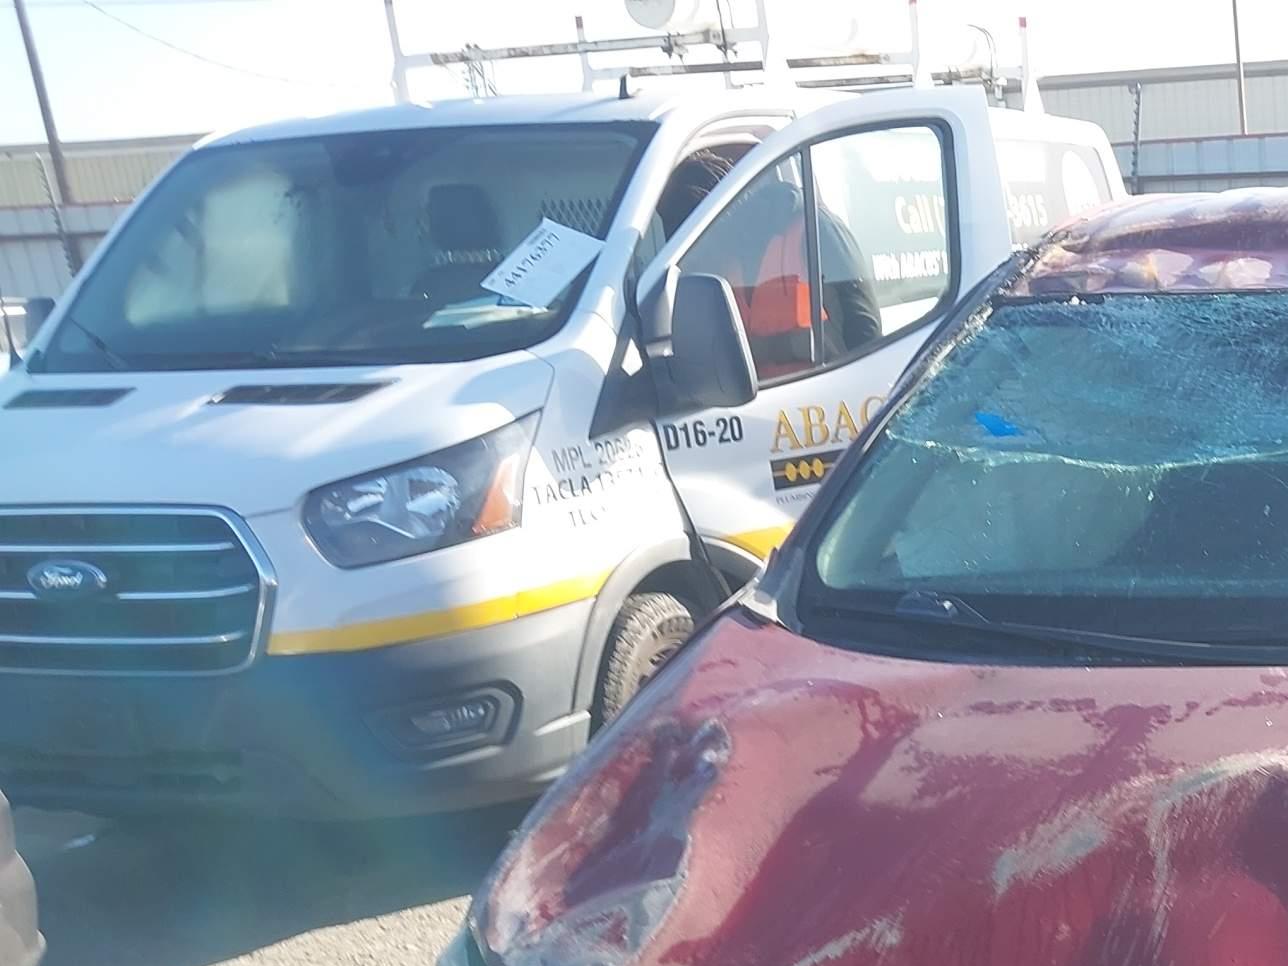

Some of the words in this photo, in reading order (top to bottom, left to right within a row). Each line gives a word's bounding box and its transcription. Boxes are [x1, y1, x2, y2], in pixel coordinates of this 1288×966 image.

[894, 193, 936, 233] Call
[662, 415, 744, 451] D16-20
[552, 445, 592, 473] MPL
